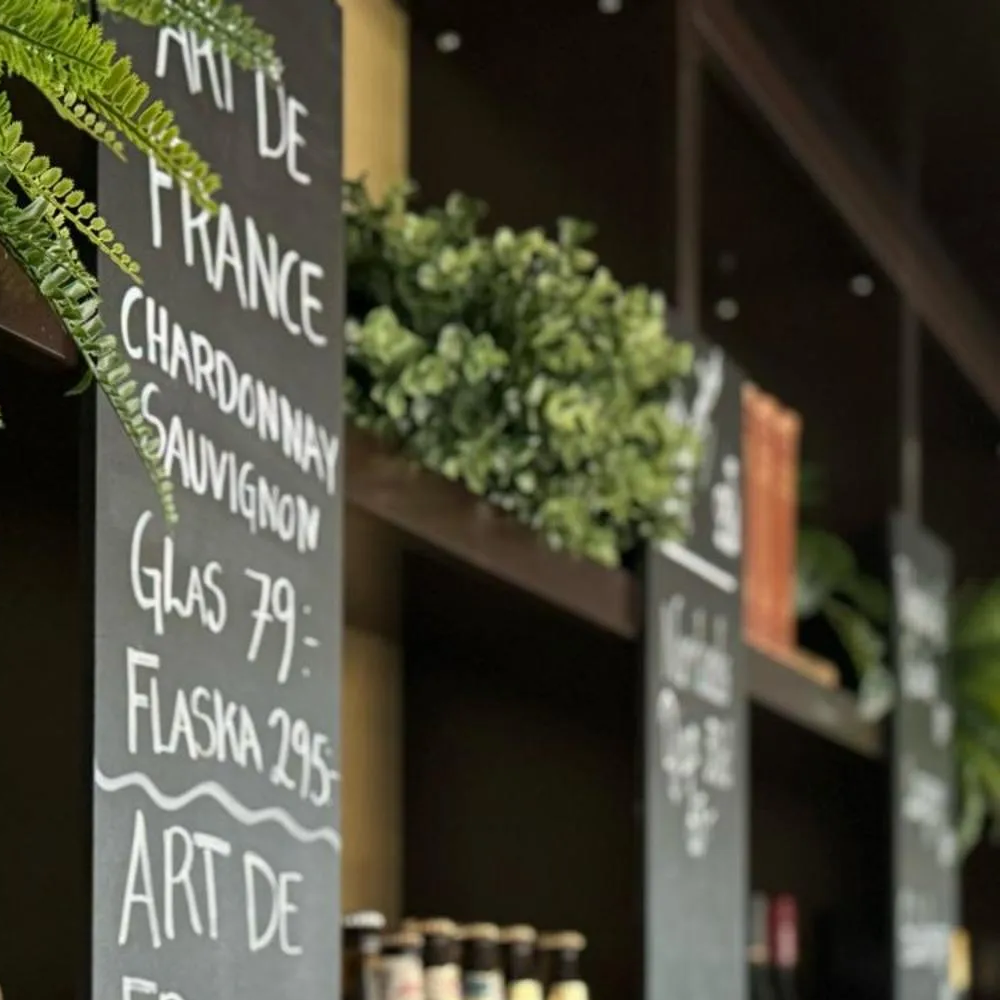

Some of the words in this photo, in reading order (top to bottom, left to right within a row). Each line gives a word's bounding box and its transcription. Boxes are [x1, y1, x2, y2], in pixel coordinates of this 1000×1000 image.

[255, 68, 311, 185] DE
[148, 150, 328, 346] FRANCE
[120, 286, 339, 496] CHARDONNAY
[140, 382, 320, 553] SAUVIGNON
[130, 510, 226, 635] GLAS
[126, 646, 263, 772] FLASKA
[118, 809, 232, 949] ART
[242, 850, 304, 955] DE
